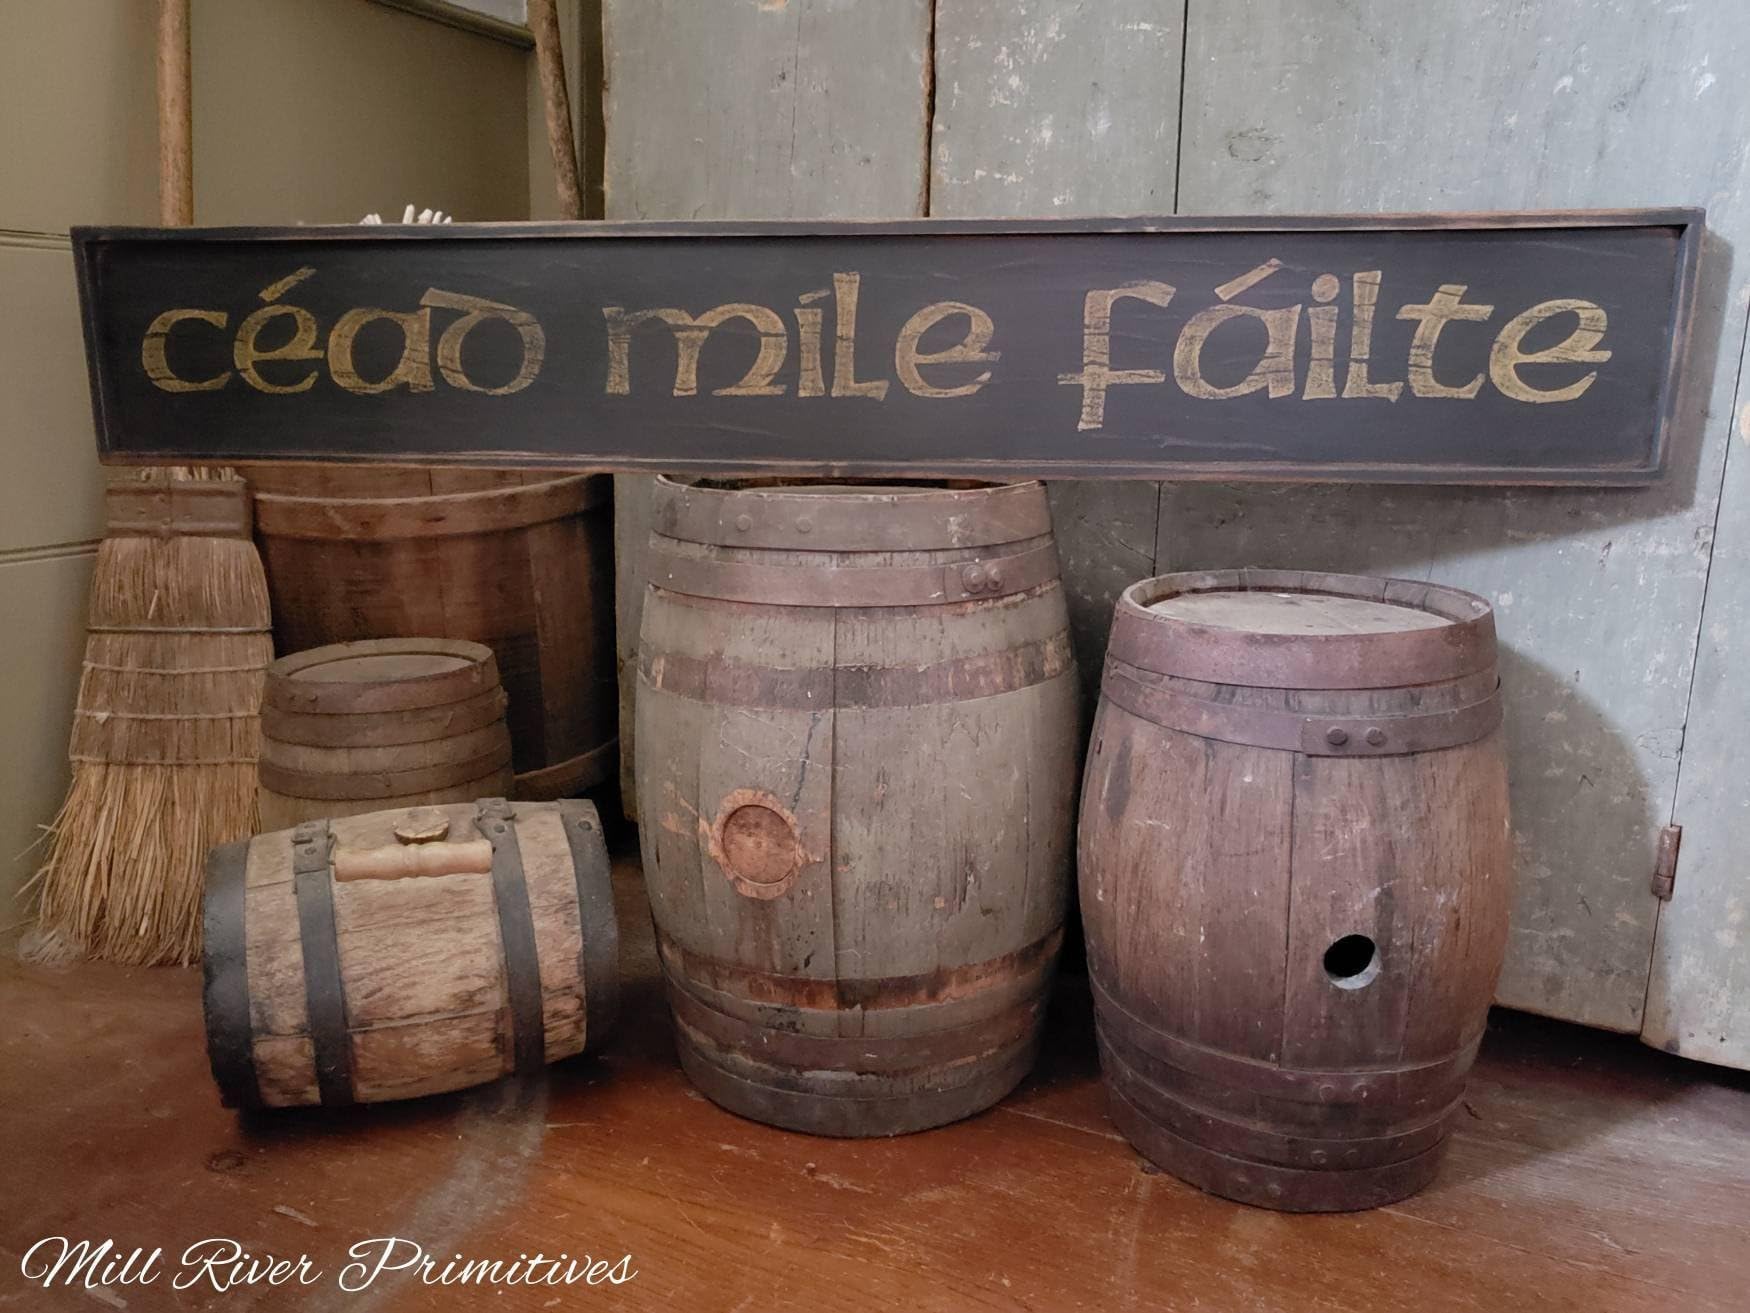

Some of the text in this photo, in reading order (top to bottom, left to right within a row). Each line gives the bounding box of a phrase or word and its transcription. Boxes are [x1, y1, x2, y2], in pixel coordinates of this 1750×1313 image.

[140, 257, 1613, 432] céad míle fáilte
